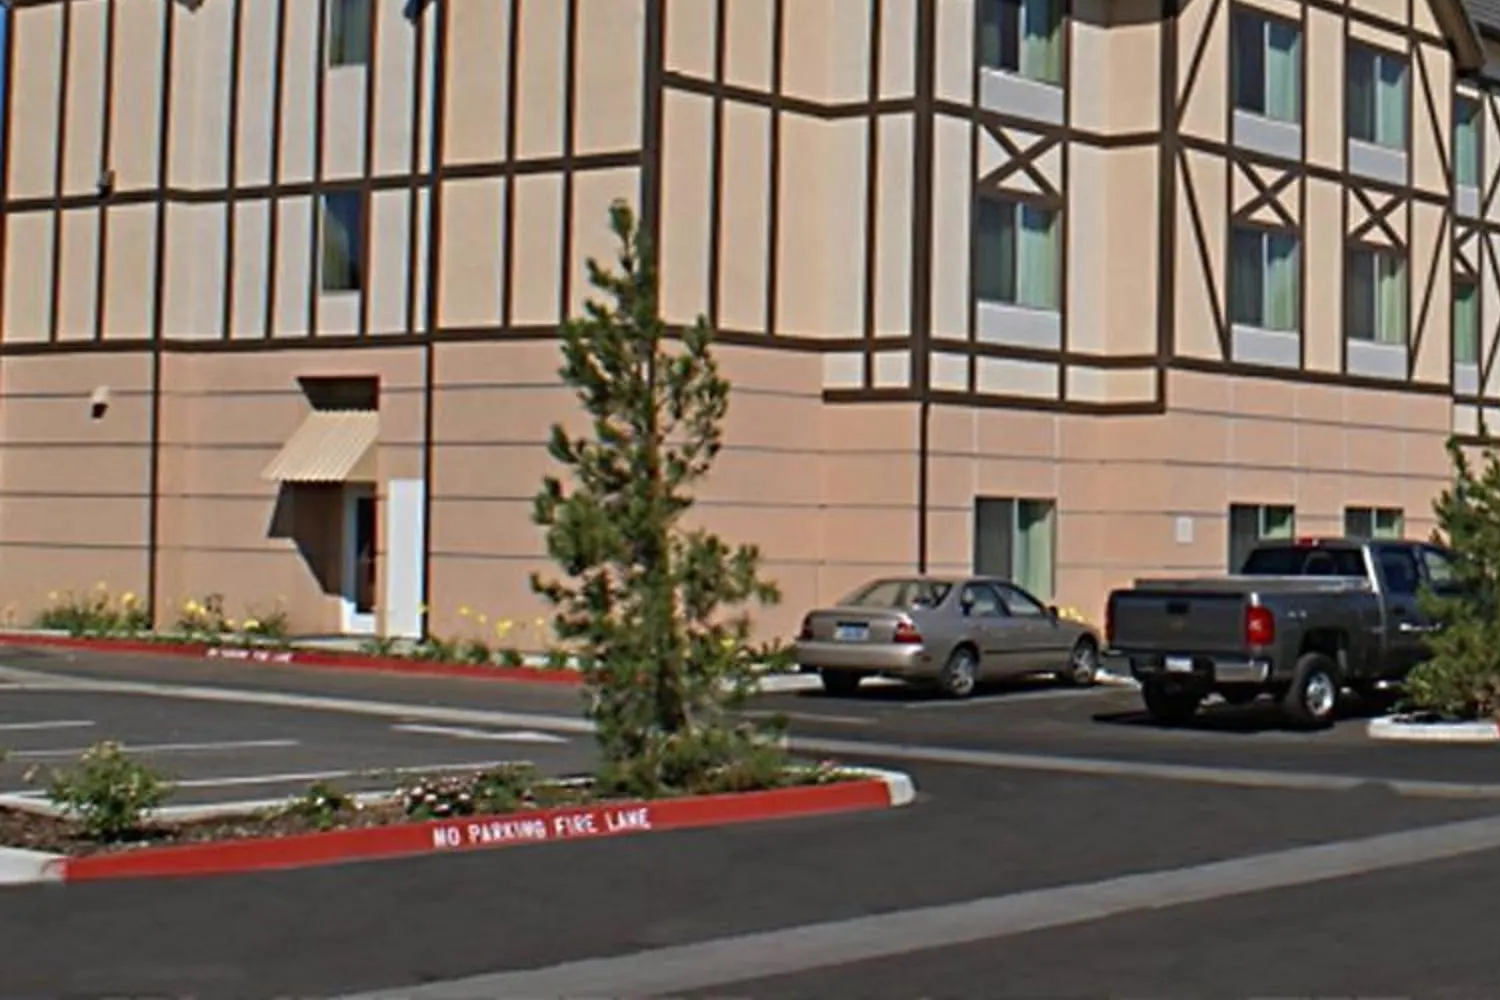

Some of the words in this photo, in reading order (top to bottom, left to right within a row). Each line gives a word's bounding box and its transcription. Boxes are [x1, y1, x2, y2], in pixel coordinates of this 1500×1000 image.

[432, 826, 462, 848] NO
[468, 819, 547, 845] PARKING
[554, 813, 598, 838] FIRE
[604, 807, 652, 832] LANE
